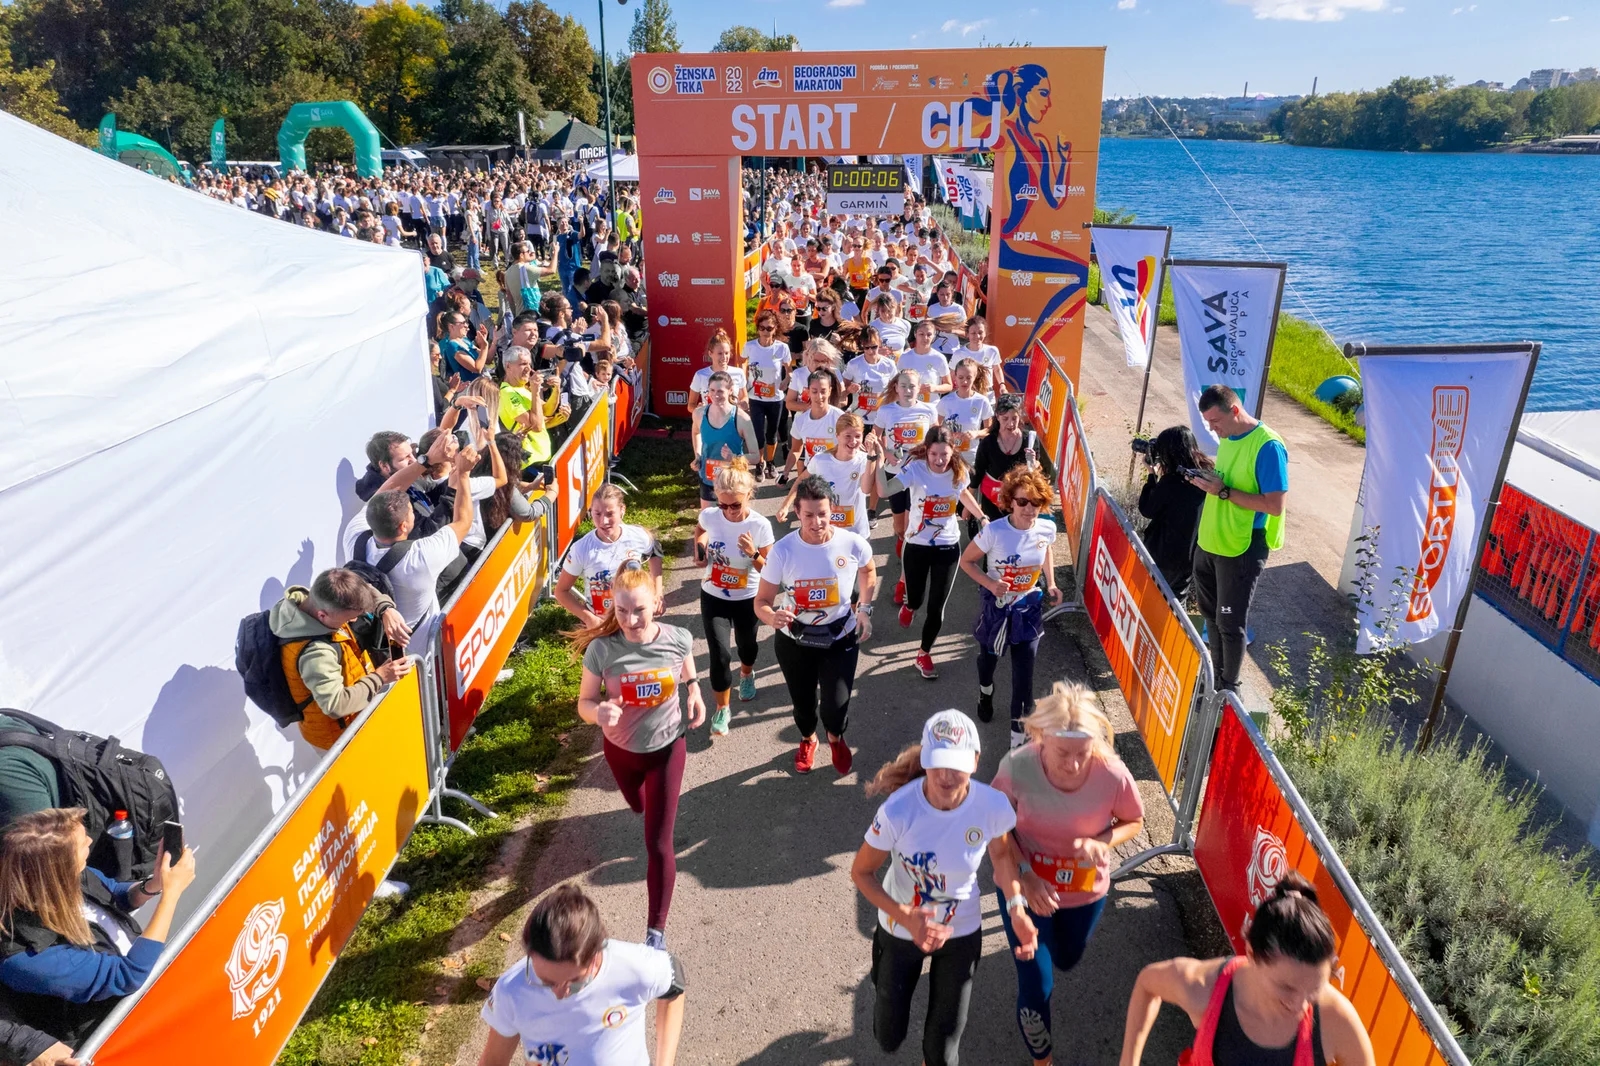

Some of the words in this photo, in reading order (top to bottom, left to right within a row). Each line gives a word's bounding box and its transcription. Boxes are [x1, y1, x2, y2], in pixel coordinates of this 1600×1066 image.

[675, 65, 716, 81] ŽENSKA
[726, 67, 742, 81] 20
[758, 67, 779, 81] dm
[794, 65, 856, 79] BEOGRADSKI
[676, 81, 704, 94] TRKA
[726, 80, 743, 93] 22
[794, 79, 843, 92] MARATON
[731, 103, 859, 151] START
[921, 101, 1001, 149] CILJ
[833, 170, 899, 187] 0:00:06
[657, 188, 673, 198] dm
[1020, 184, 1037, 195] dm
[1067, 185, 1086, 193] SAVA
[840, 200, 888, 209] GARMIN
[1201, 289, 1228, 374] SAVA
[901, 429, 917, 438] 430
[934, 502, 950, 512] 449
[830, 512, 846, 522] 253
[1412, 491, 1453, 617] SPORT
[721, 573, 739, 584] 545
[1013, 574, 1032, 585] 346
[809, 589, 827, 601] 231
[459, 576, 513, 688] SPORT
[1095, 546, 1137, 641] SPORT
[1136, 620, 1177, 723] TIME
[636, 682, 662, 699] 1175
[292, 819, 334, 883] БАНКА
[297, 799, 369, 907] ПОШТАНСКА
[302, 810, 379, 931] ШТЕДИОНИЦА
[251, 989, 283, 1039] 1921
